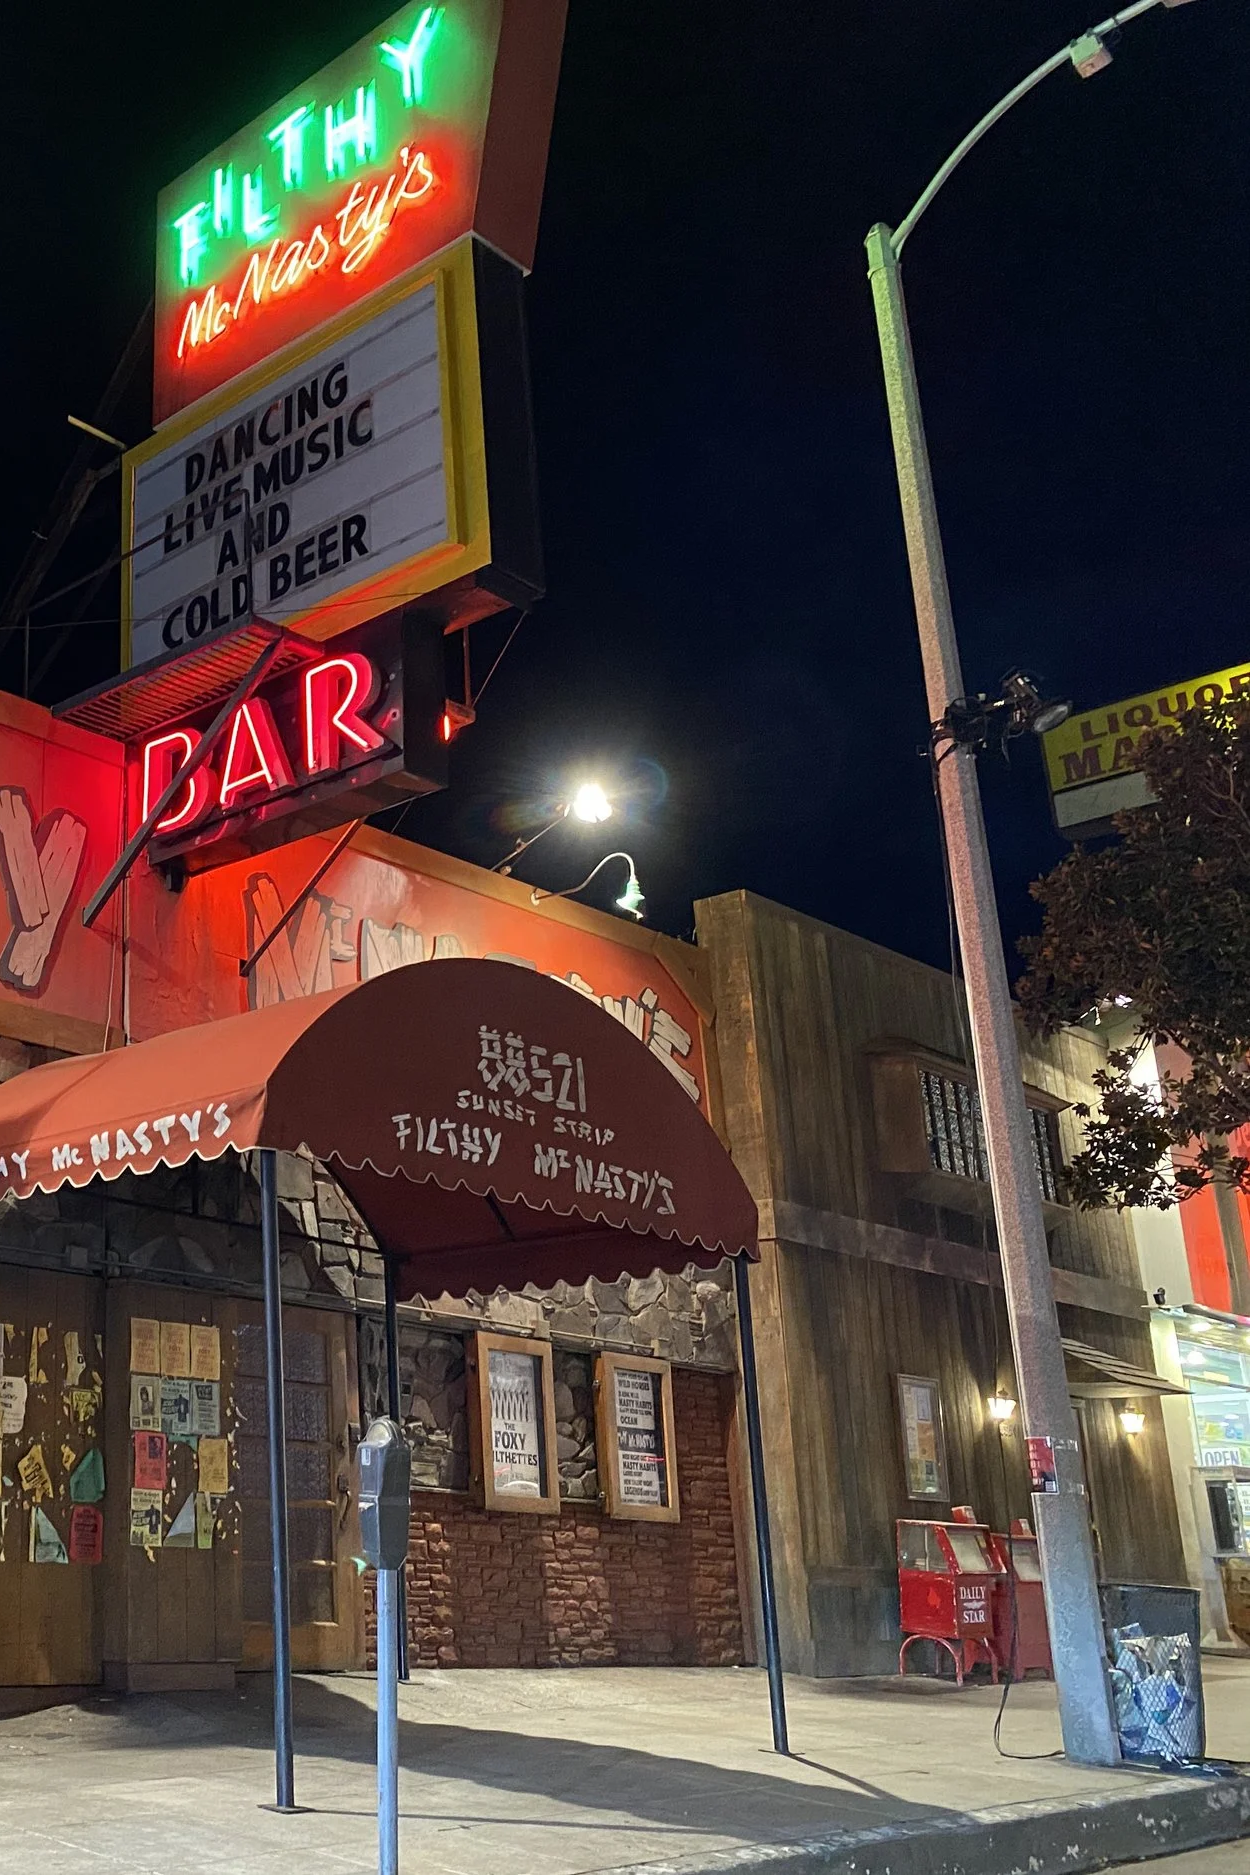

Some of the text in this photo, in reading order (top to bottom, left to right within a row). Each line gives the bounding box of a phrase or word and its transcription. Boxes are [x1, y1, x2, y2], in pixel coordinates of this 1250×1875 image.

[173, 5, 446, 289] FILTHY
[184, 361, 349, 496] DANCING
[162, 399, 374, 555] LIVE MUSIC
[216, 501, 291, 576] AND
[161, 513, 370, 650] COLD BEER
[141, 652, 385, 832] BAR
[391, 1113, 502, 1167] FILTHY
[456, 1089, 615, 1146] SUNSET STRIP
[494, 1431, 527, 1451] FOXY
[504, 1422, 516, 1431] THE
[493, 1450, 538, 1467] ILTHETTES
[1204, 1450, 1240, 1467] OPEN
[959, 1586, 986, 1600] DAILY
[963, 1609, 986, 1624] STAR
